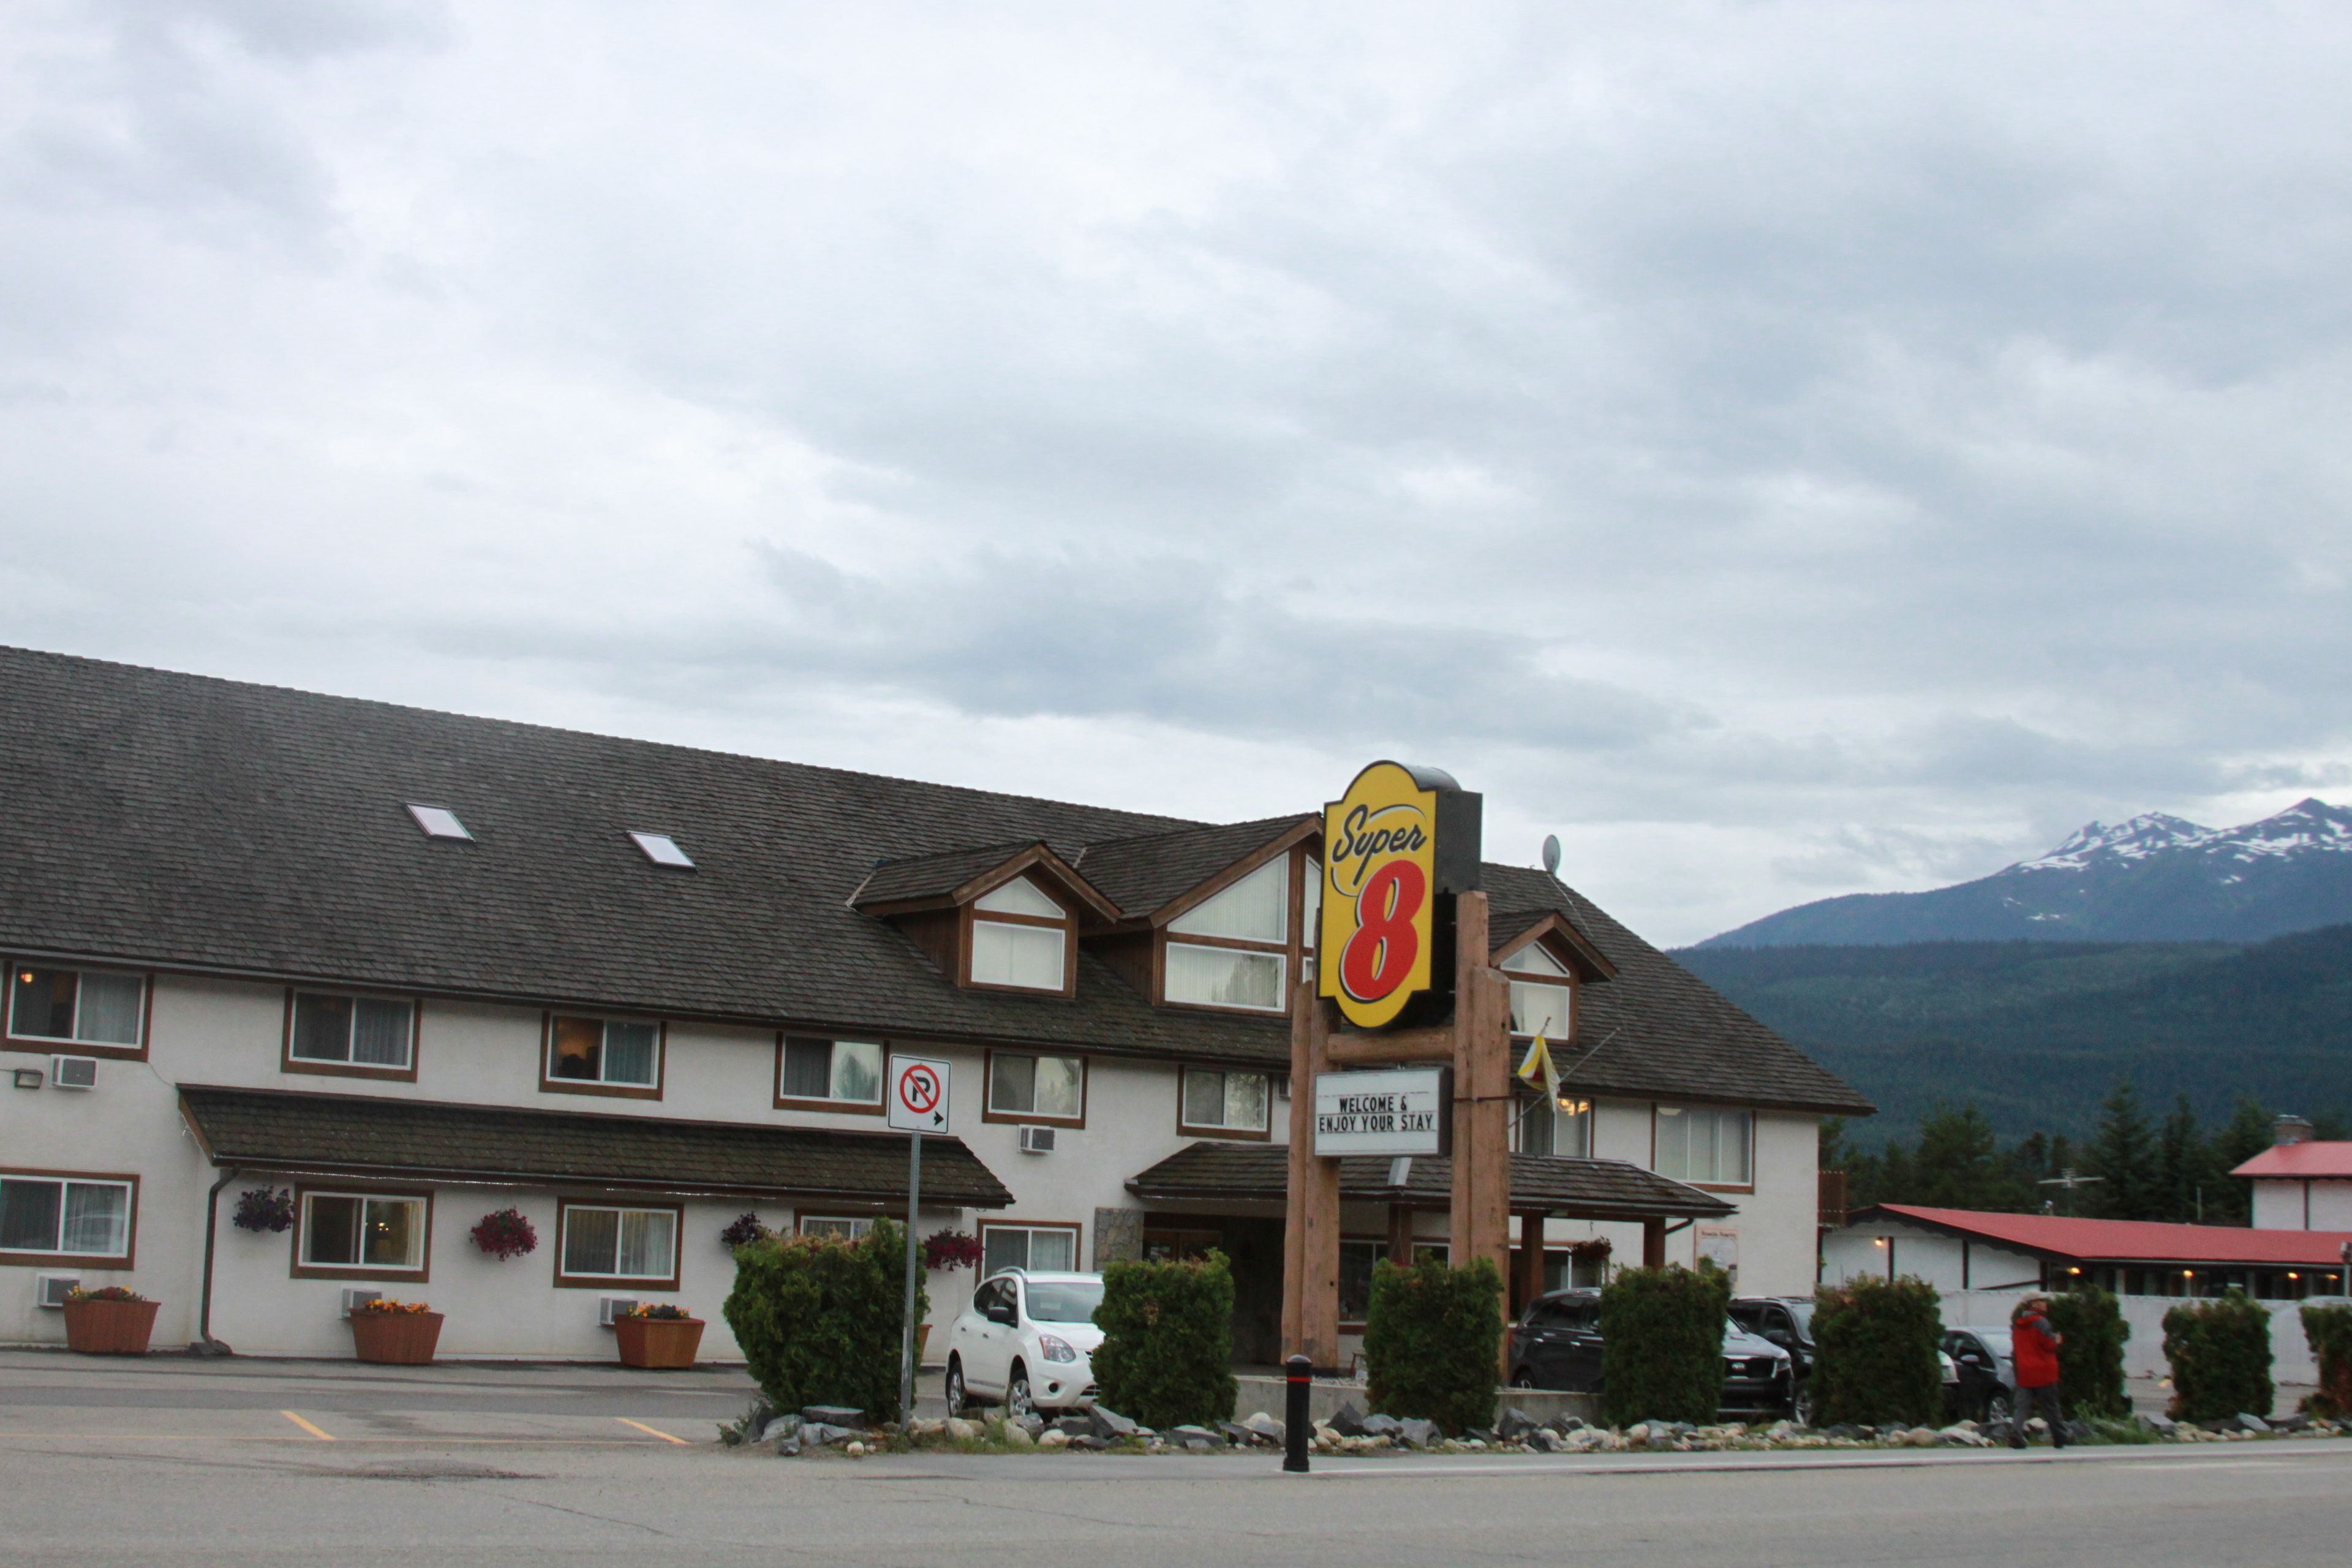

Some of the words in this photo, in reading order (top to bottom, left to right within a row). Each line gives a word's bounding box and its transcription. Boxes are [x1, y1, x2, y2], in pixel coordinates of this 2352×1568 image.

[1332, 804, 1427, 886] Super
[1340, 859, 1426, 1004] 8
[912, 1076, 931, 1102] P
[1340, 1096, 1394, 1112] WELCOME
[1401, 1096, 1407, 1111] &
[1319, 1116, 1356, 1132] ENJOY
[1362, 1115, 1394, 1131] YOUR
[1401, 1114, 1433, 1130] STAY
